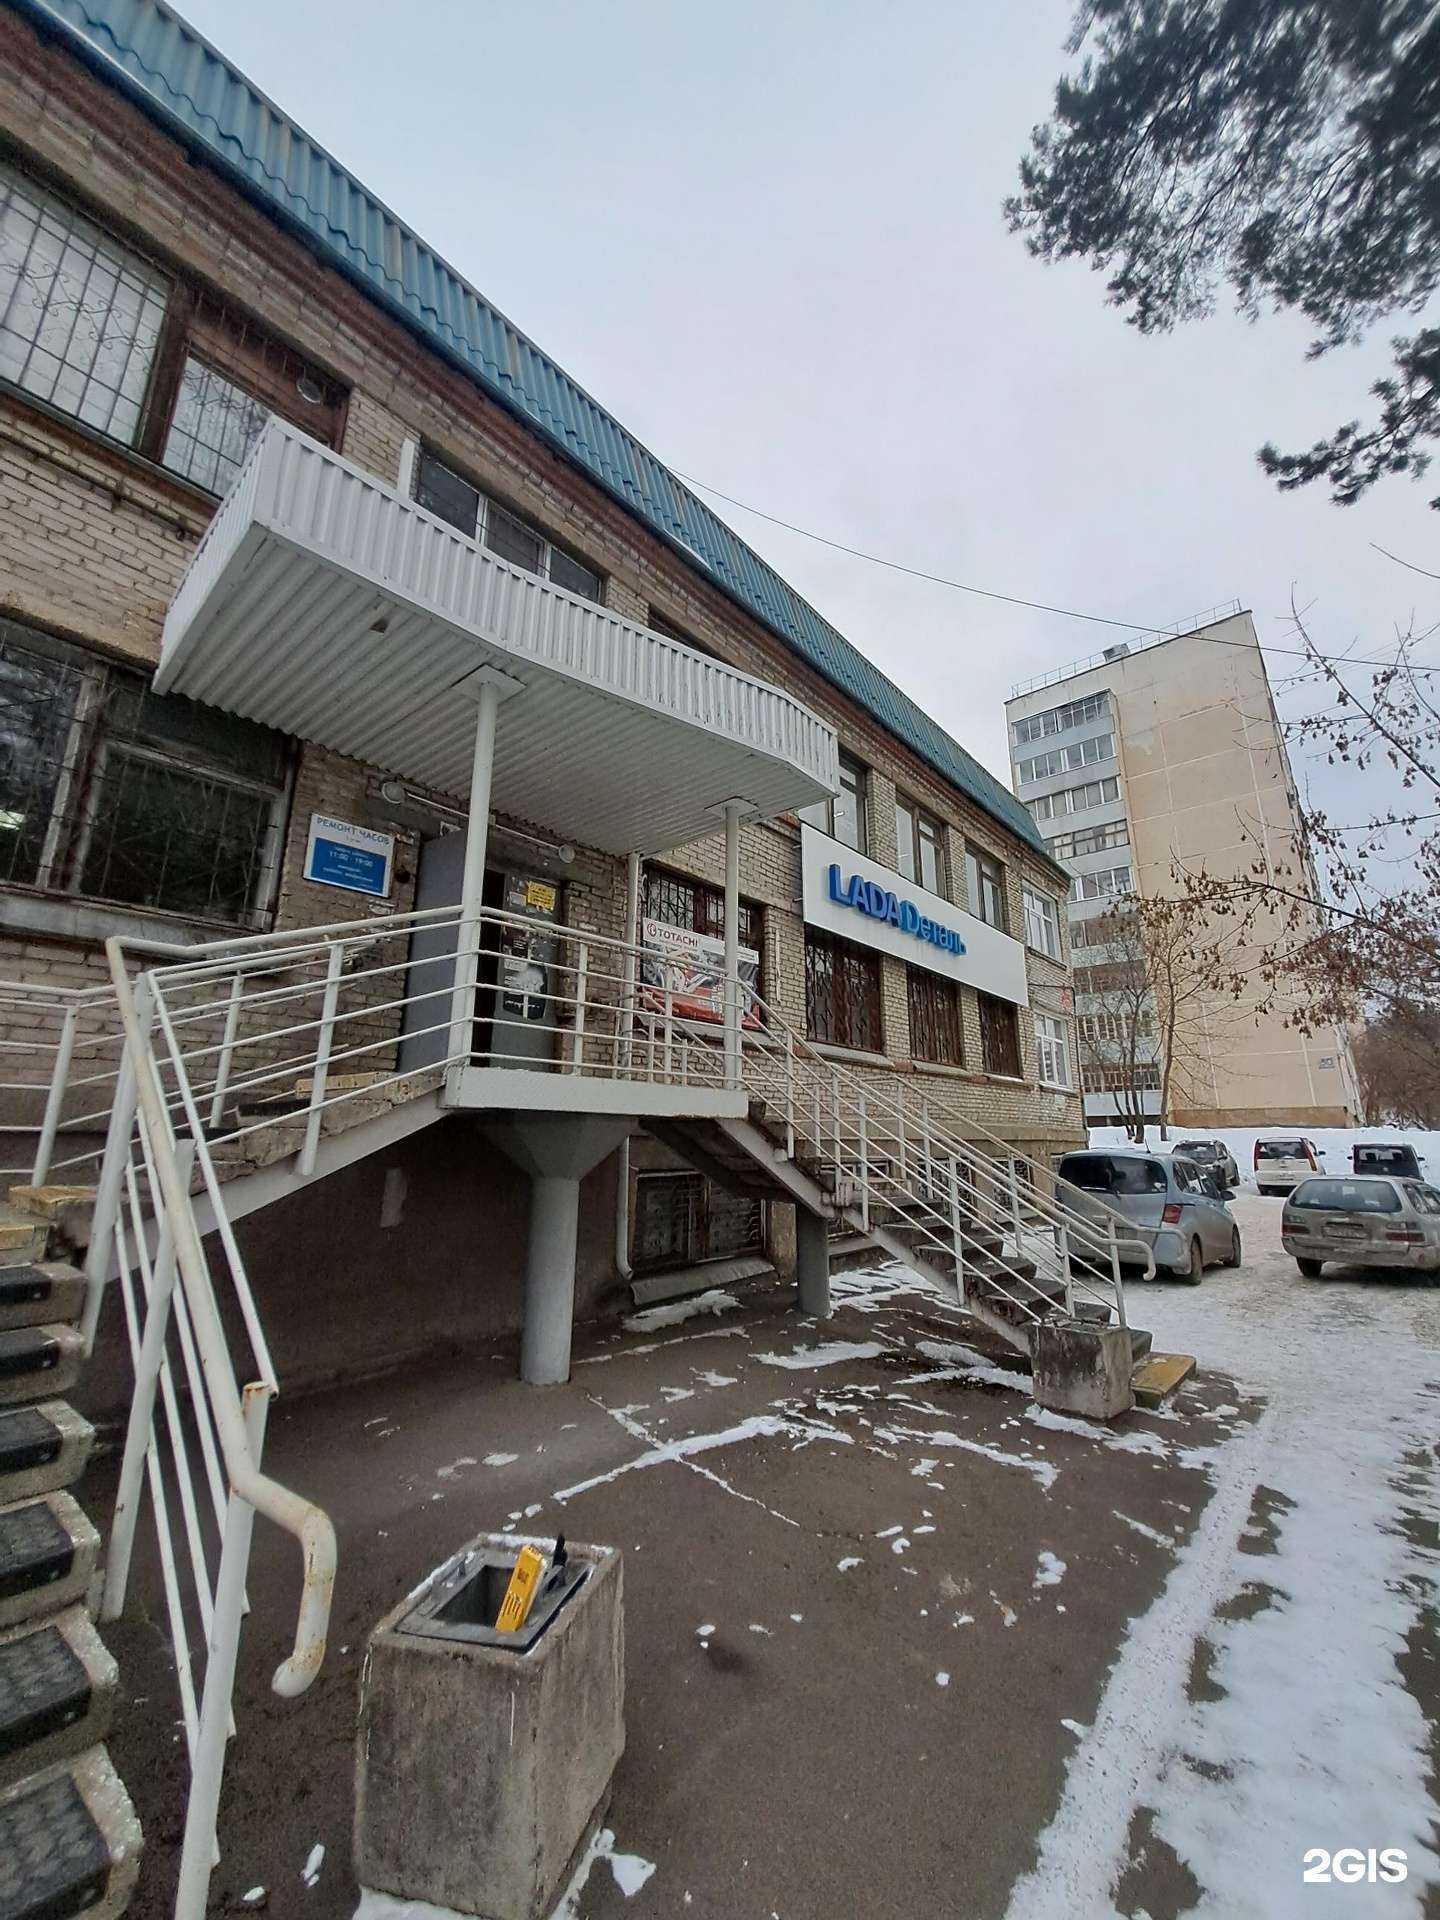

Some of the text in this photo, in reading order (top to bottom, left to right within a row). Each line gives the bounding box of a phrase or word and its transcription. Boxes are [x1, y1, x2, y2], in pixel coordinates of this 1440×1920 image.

[316, 817, 358, 835] РЕМОНТ
[359, 831, 390, 845] ЧАСОВ
[829, 863, 902, 929] LADA
[657, 927, 698, 948] TOTACHI
